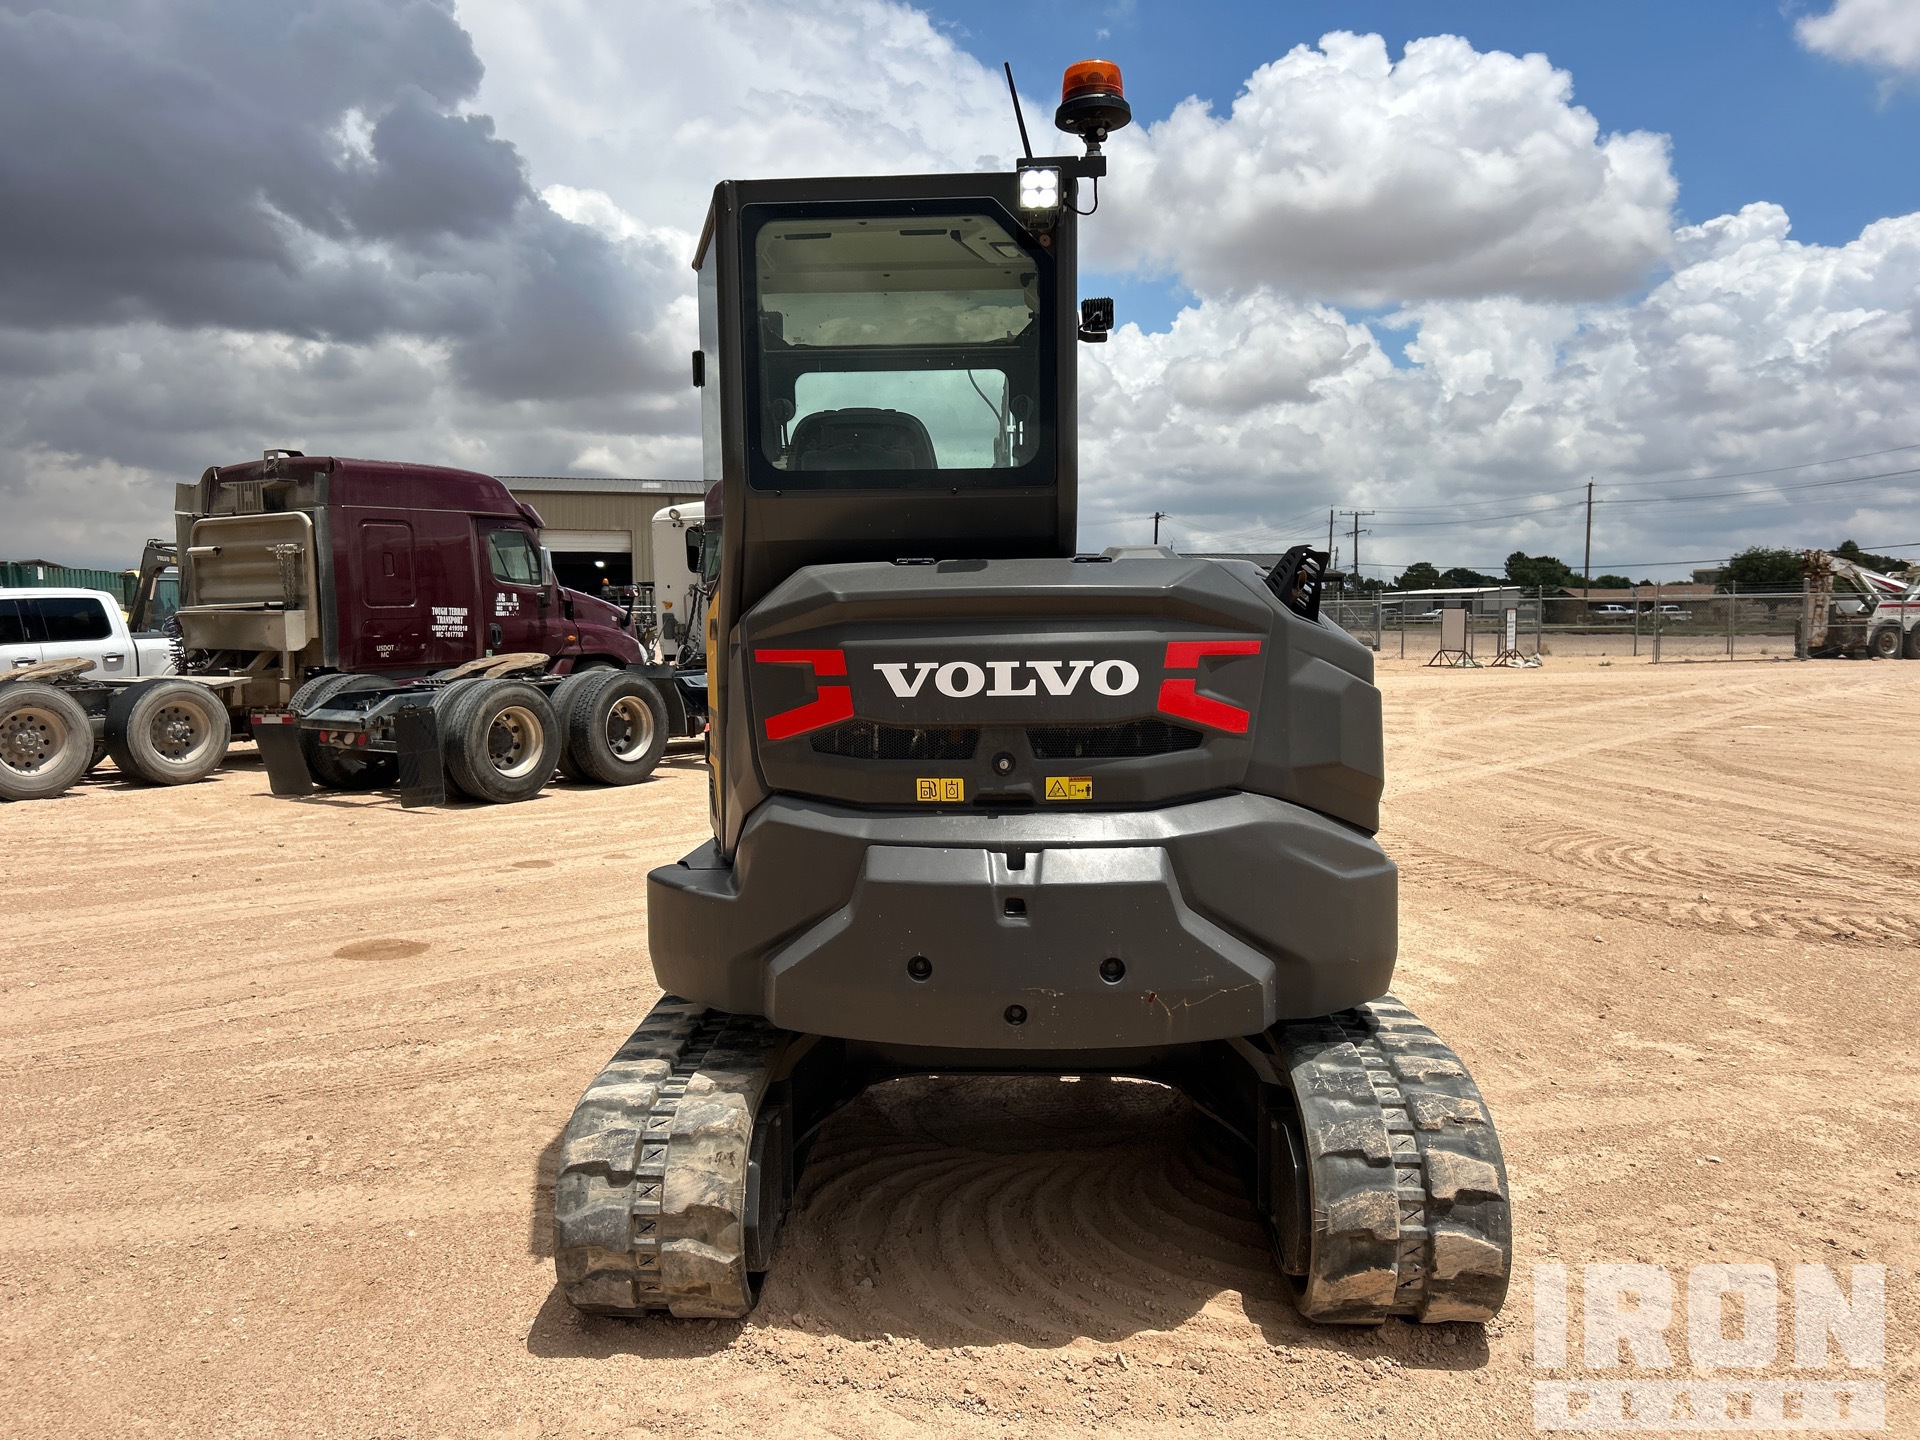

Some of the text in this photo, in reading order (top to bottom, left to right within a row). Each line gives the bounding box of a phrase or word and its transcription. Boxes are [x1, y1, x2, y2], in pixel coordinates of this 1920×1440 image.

[431, 606, 468, 616] TOUGH TERRAIN
[436, 615, 464, 625] TRANSPORT
[431, 624, 448, 632] USDOT
[376, 644, 395, 652] USDOT
[380, 651, 390, 659] MC
[873, 659, 1140, 698] VOLVO
